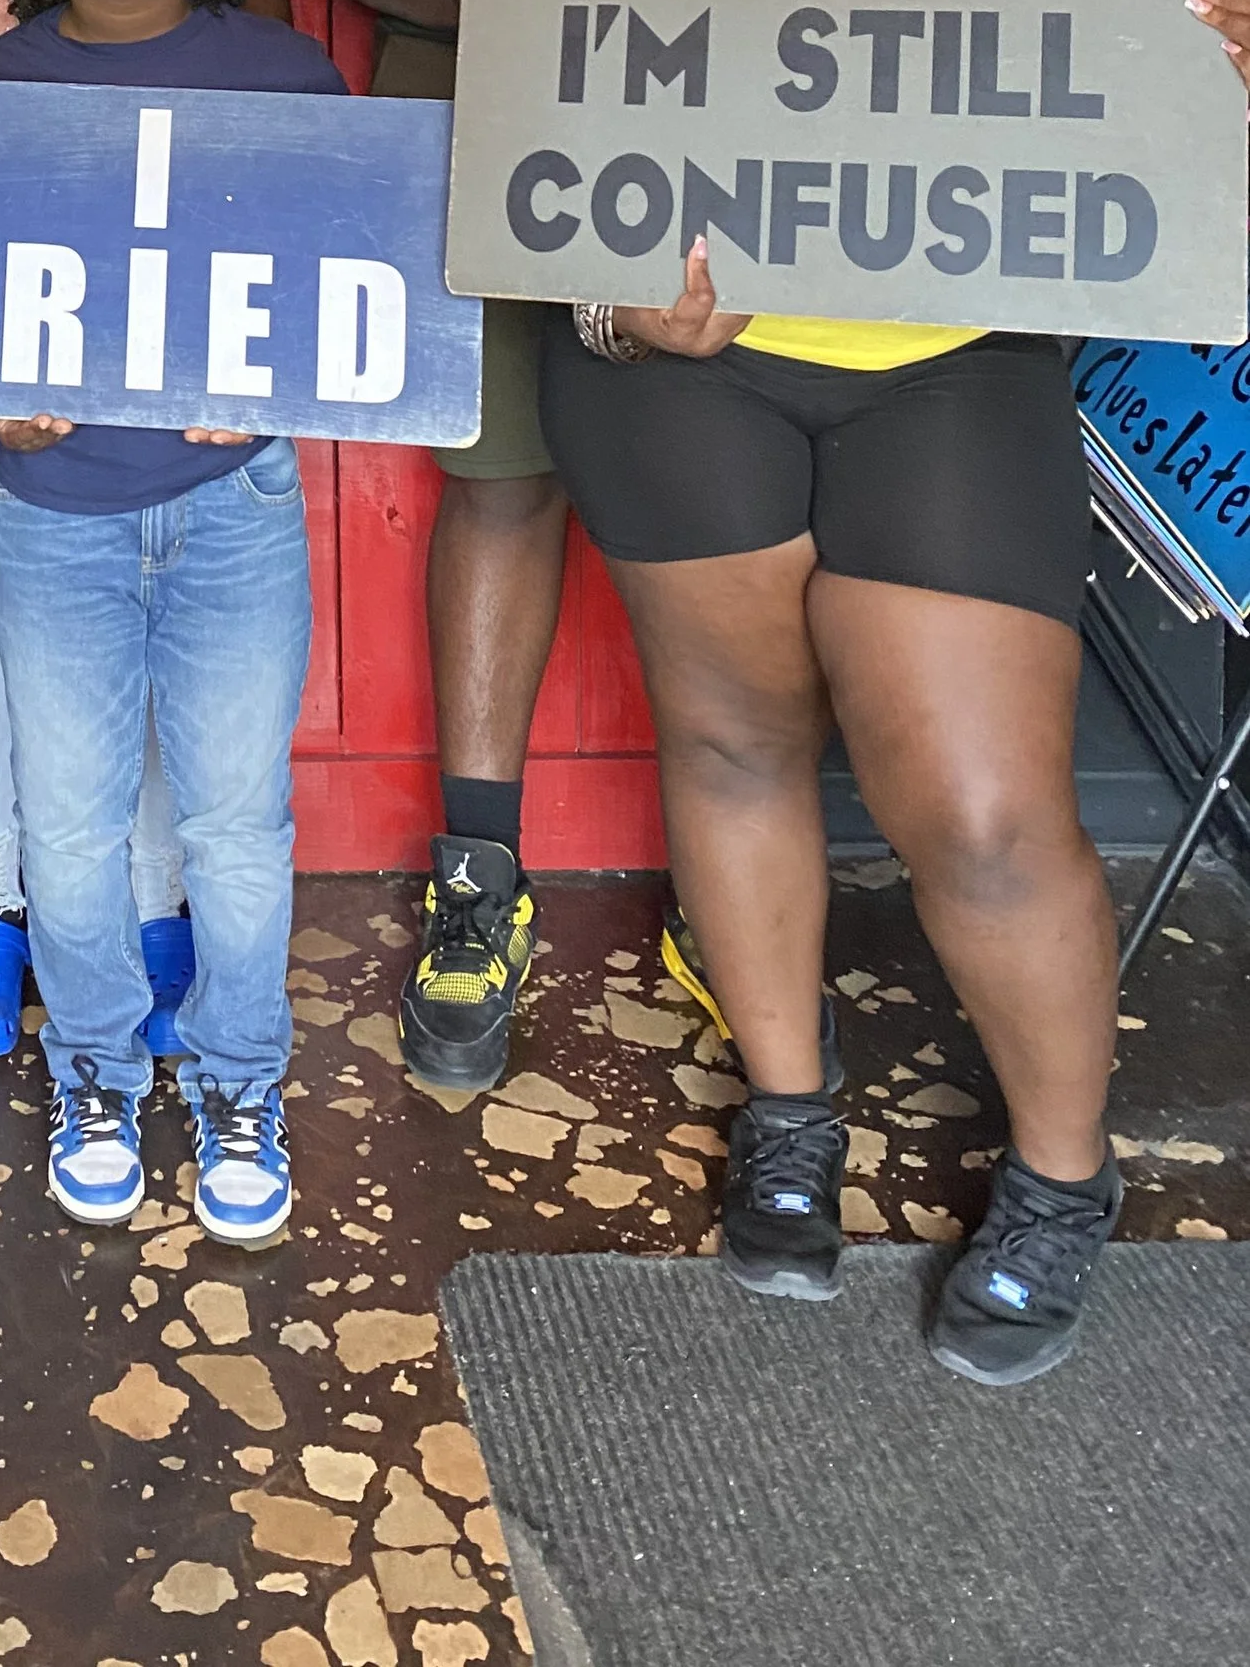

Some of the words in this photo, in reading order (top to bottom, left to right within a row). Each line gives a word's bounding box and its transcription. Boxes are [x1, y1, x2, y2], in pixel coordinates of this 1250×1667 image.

[558, 4, 711, 108] I'M
[774, 6, 1106, 120] STILL
[134, 108, 173, 229] I
[506, 148, 1158, 283] CONFUSED
